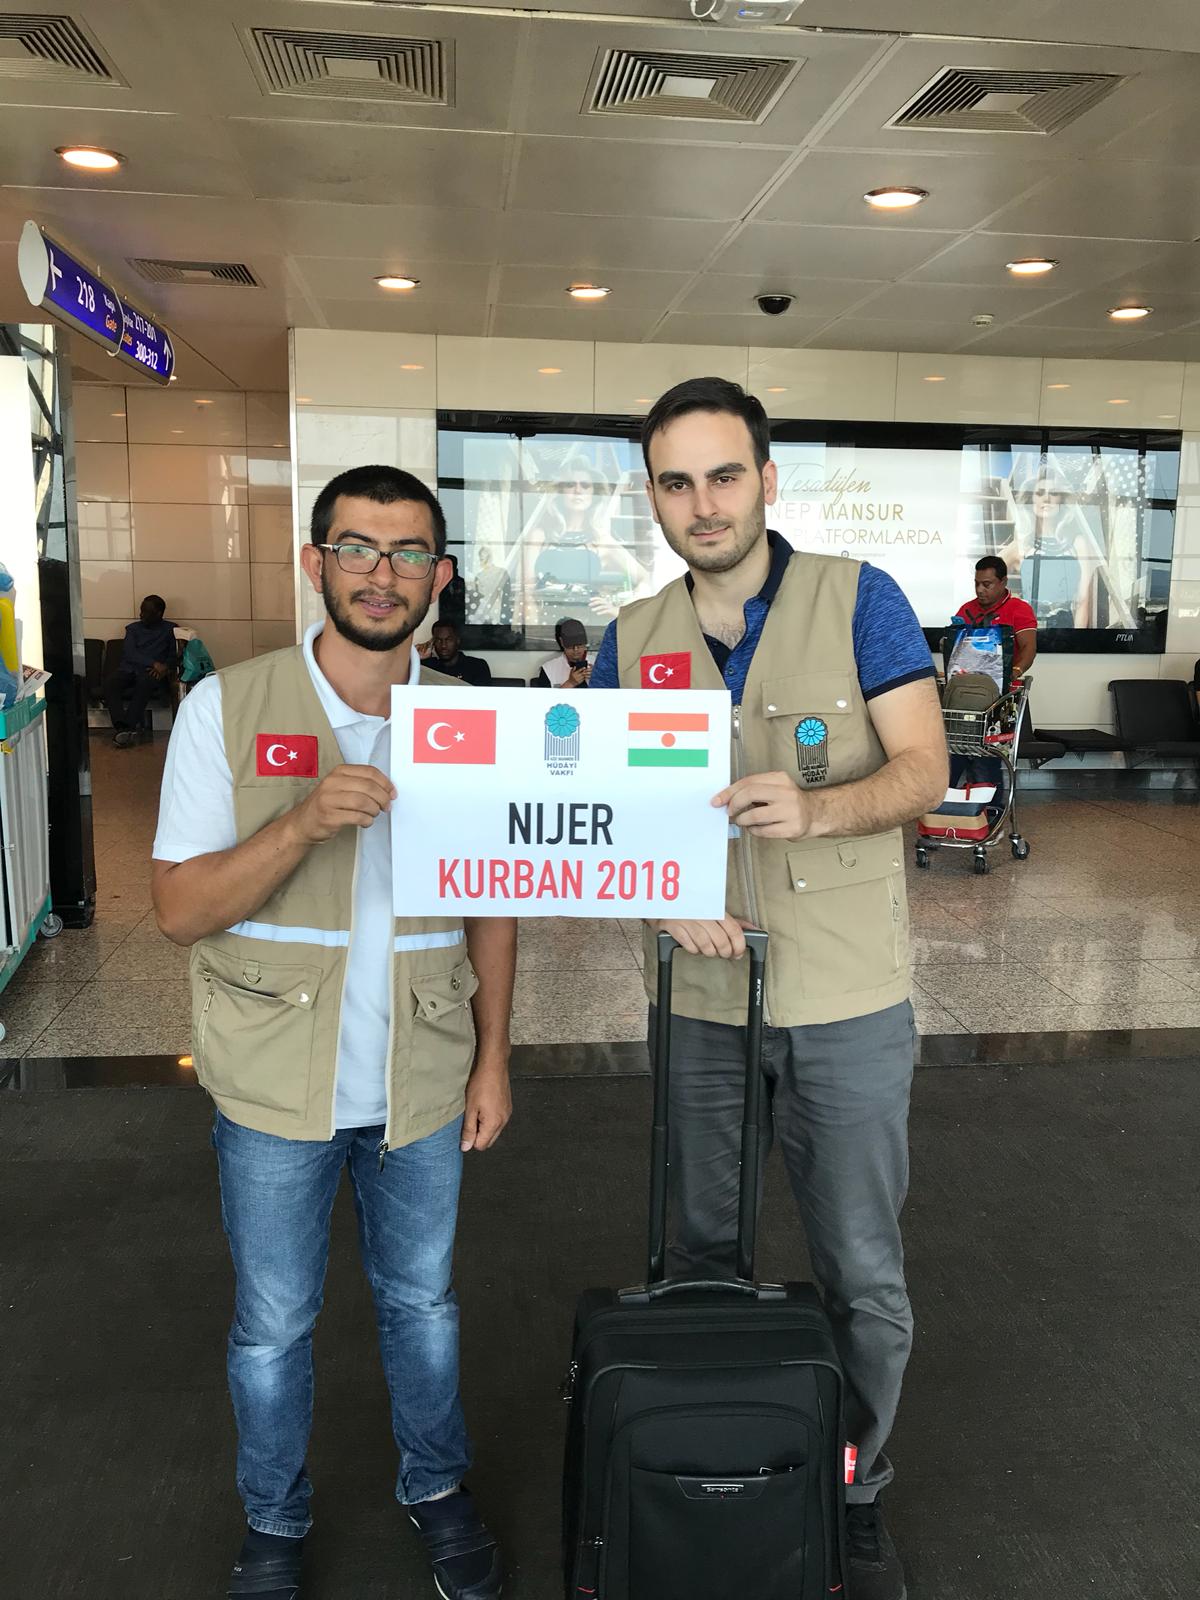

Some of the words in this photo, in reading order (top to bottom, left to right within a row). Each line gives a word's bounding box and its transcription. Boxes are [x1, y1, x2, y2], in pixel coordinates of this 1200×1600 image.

[76, 276, 96, 313] 218
[105, 314, 117, 333] Gate
[135, 340, 159, 370] 300-312
[818, 502, 904, 521] MANSUR
[793, 528, 943, 545] PLATFORMLARDA
[508, 802, 614, 846] NIJER
[438, 858, 583, 900] KURBAN
[596, 860, 681, 902] 2018
